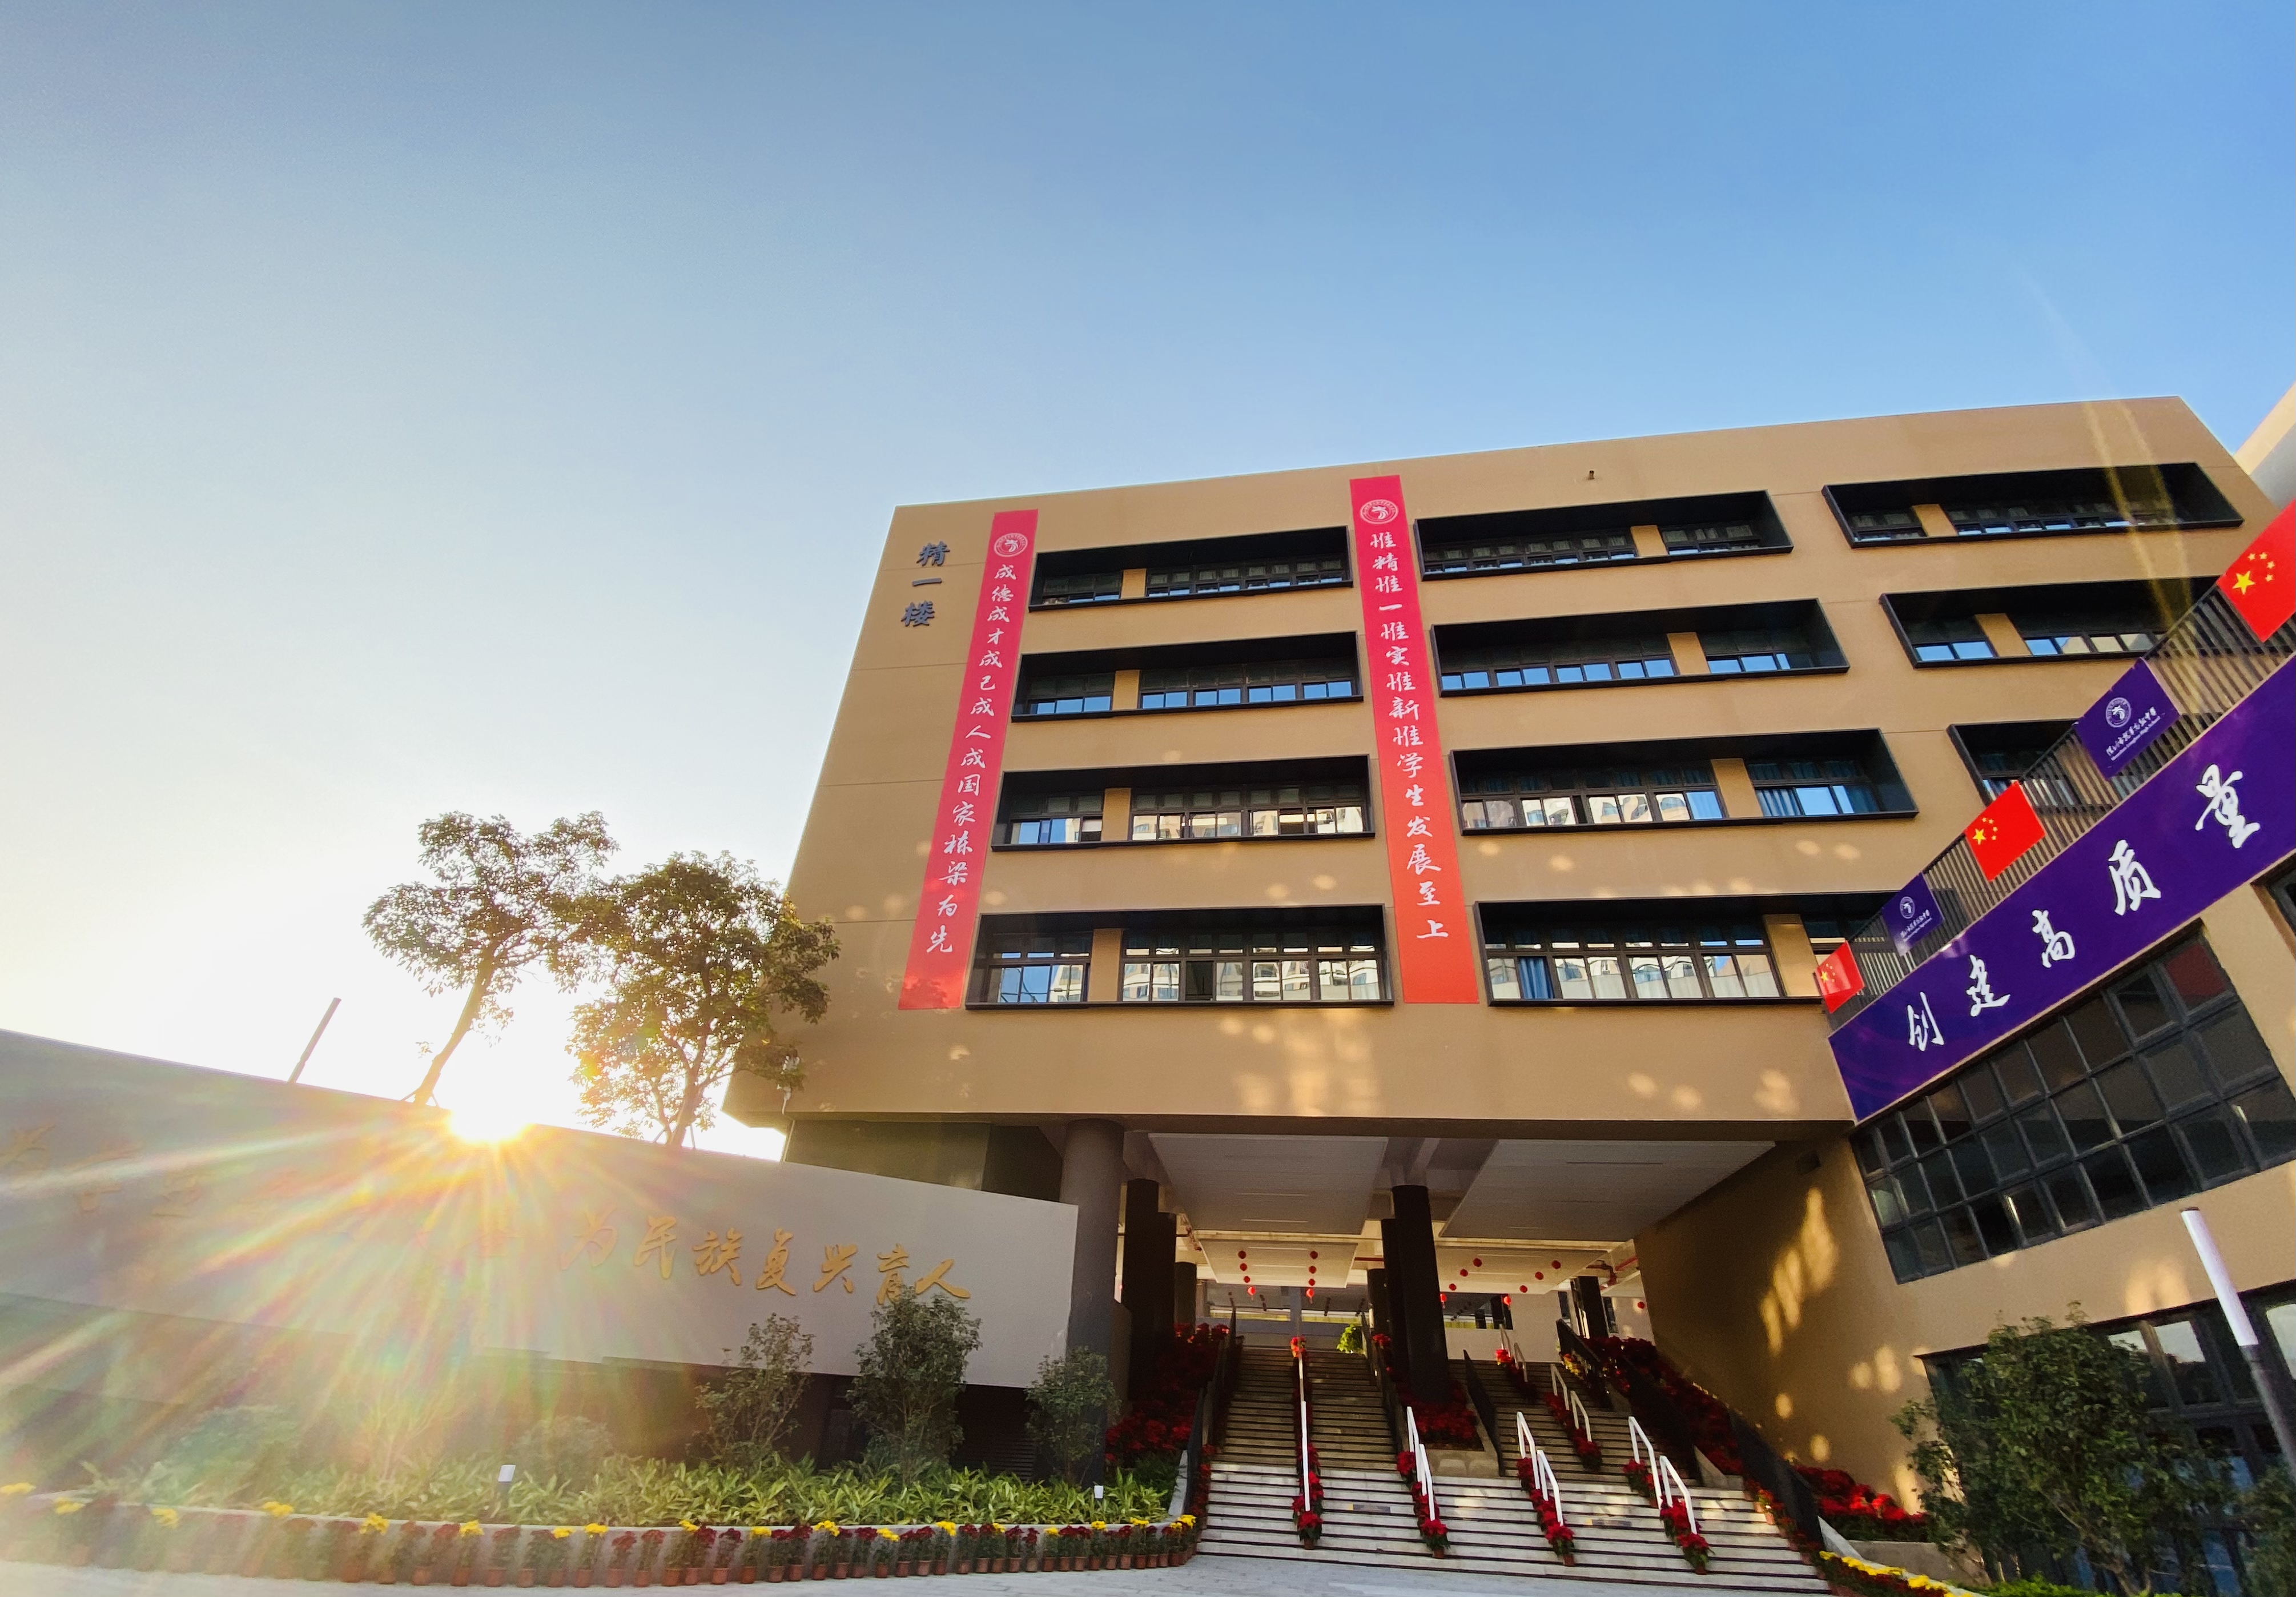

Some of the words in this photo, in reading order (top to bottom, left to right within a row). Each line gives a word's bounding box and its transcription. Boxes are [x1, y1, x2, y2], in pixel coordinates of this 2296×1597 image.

[900, 540, 951, 627] 精一楼
[1907, 763, 2261, 1052] 创建高质量
